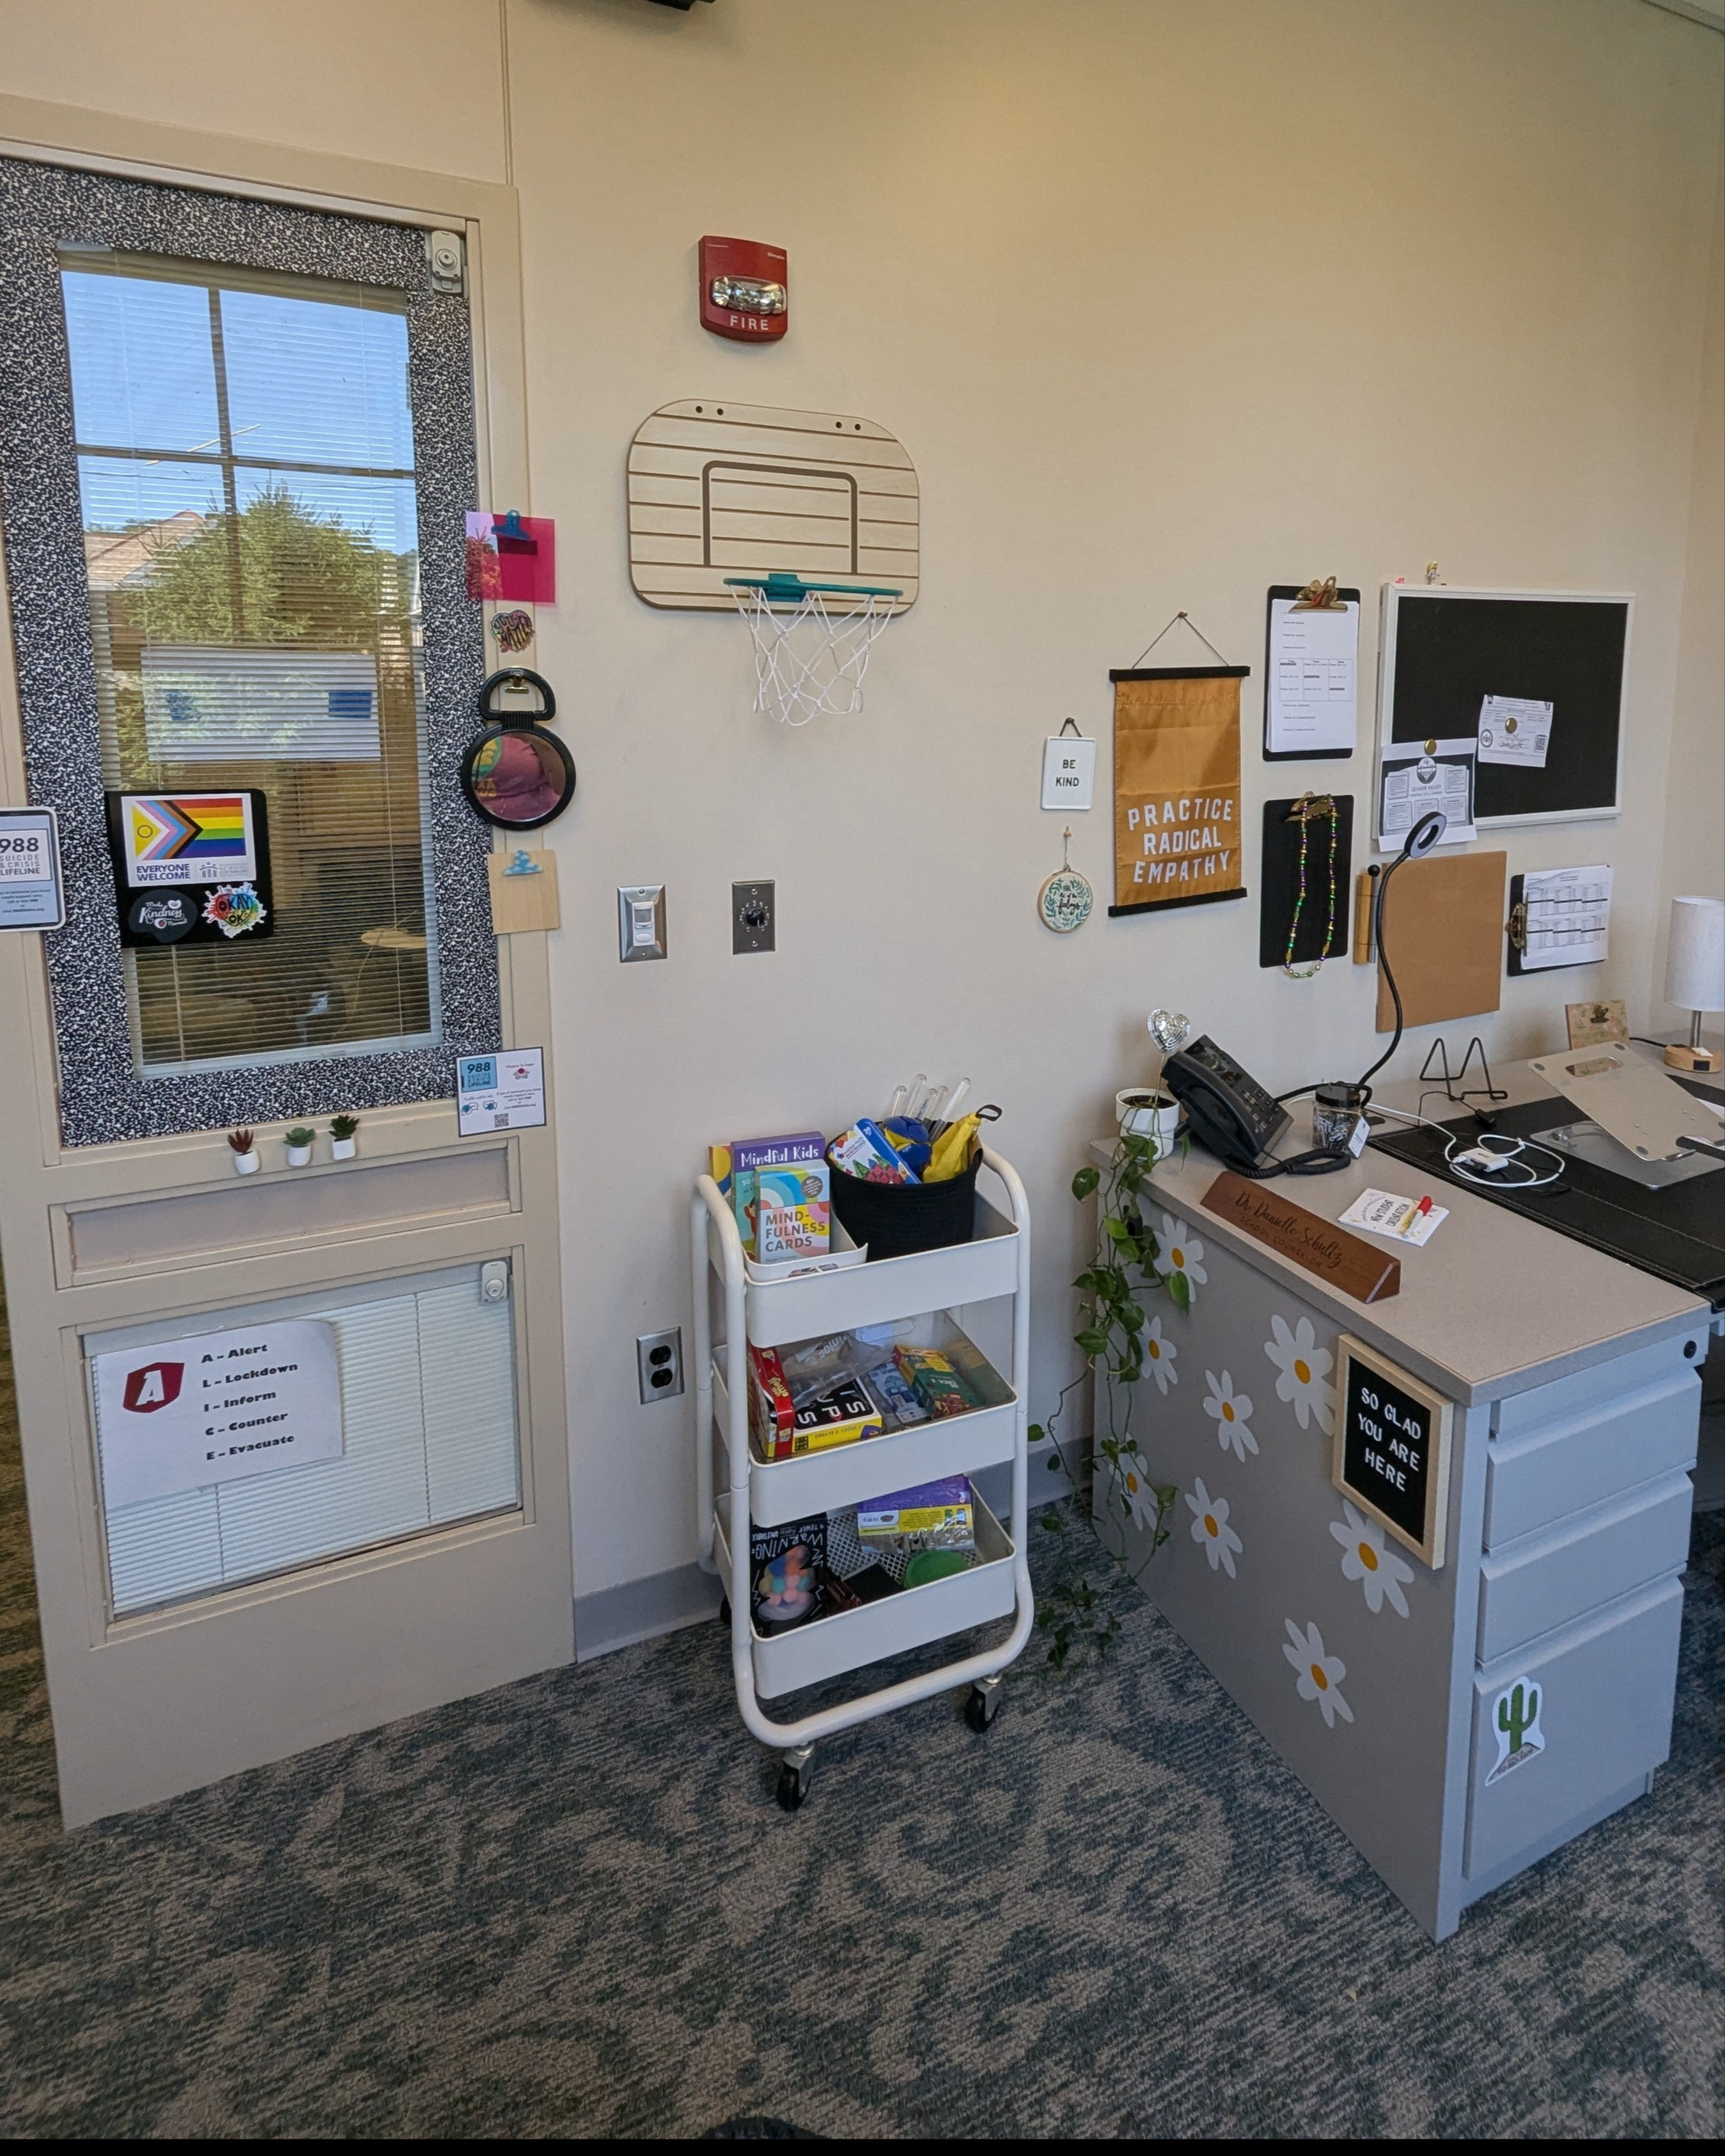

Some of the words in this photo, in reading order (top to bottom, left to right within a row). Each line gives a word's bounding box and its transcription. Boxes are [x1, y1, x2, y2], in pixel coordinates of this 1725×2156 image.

[730, 315, 769, 330] FIRE
[1063, 759, 1075, 769] BE
[1056, 777, 1079, 787] KIND
[1127, 798, 1233, 830] PRACTICE
[0, 837, 39, 853] 988
[1144, 826, 1221, 855] RADICAL
[1, 867, 40, 876] LIFELINE
[136, 864, 190, 873] EVERYONE
[137, 871, 191, 881] WELCOME
[1133, 851, 1229, 883] EMPATHY
[139, 905, 182, 924] Kindness
[467, 1062, 490, 1074] 988
[741, 1148, 788, 1167] Mindful
[793, 1145, 818, 1159] Kids
[766, 1211, 809, 1225] MIND-
[766, 1221, 825, 1239] FULNESS
[1254, 1202, 1298, 1235] Danielle
[1300, 1227, 1343, 1268] Schultz
[765, 1236, 812, 1252] CARDS
[1274, 1236, 1323, 1268] COUNSELOR
[201, 1354, 213, 1363] A
[228, 1344, 267, 1358] Alert
[203, 1379, 211, 1388] L
[226, 1363, 297, 1383] Lockdown
[224, 1391, 276, 1408] Inform
[1361, 1387, 1379, 1410] SO
[1384, 1404, 1421, 1439] GLAD
[205, 1427, 214, 1436] C
[229, 1412, 288, 1431] Counter
[815, 1431, 834, 1439] CREATE
[1358, 1413, 1382, 1441] YOU
[1389, 1439, 1420, 1471] ARE
[207, 1452, 215, 1460] E
[230, 1434, 294, 1455] Evacuate
[1365, 1448, 1406, 1492] HERE
